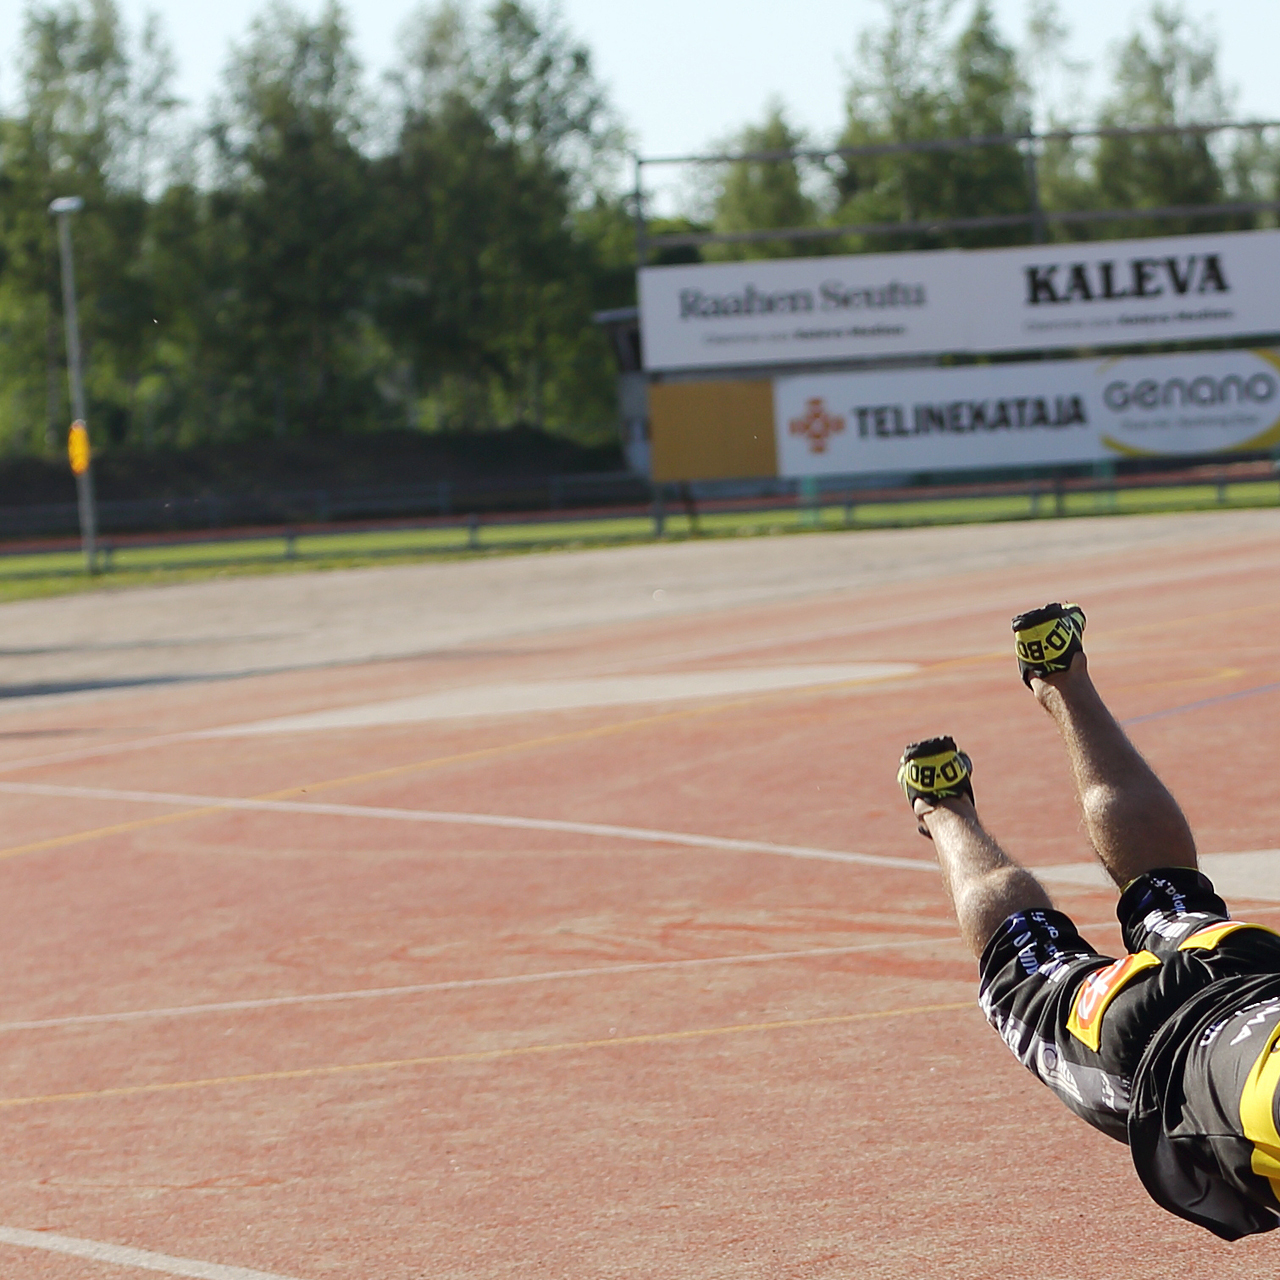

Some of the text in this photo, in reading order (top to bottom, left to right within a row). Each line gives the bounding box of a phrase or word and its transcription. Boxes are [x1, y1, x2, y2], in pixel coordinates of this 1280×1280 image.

[679, 279, 926, 322] Raahen Seutu
[1024, 252, 1231, 305] KALEVA
[852, 393, 1088, 441] TELINEKATAJA
